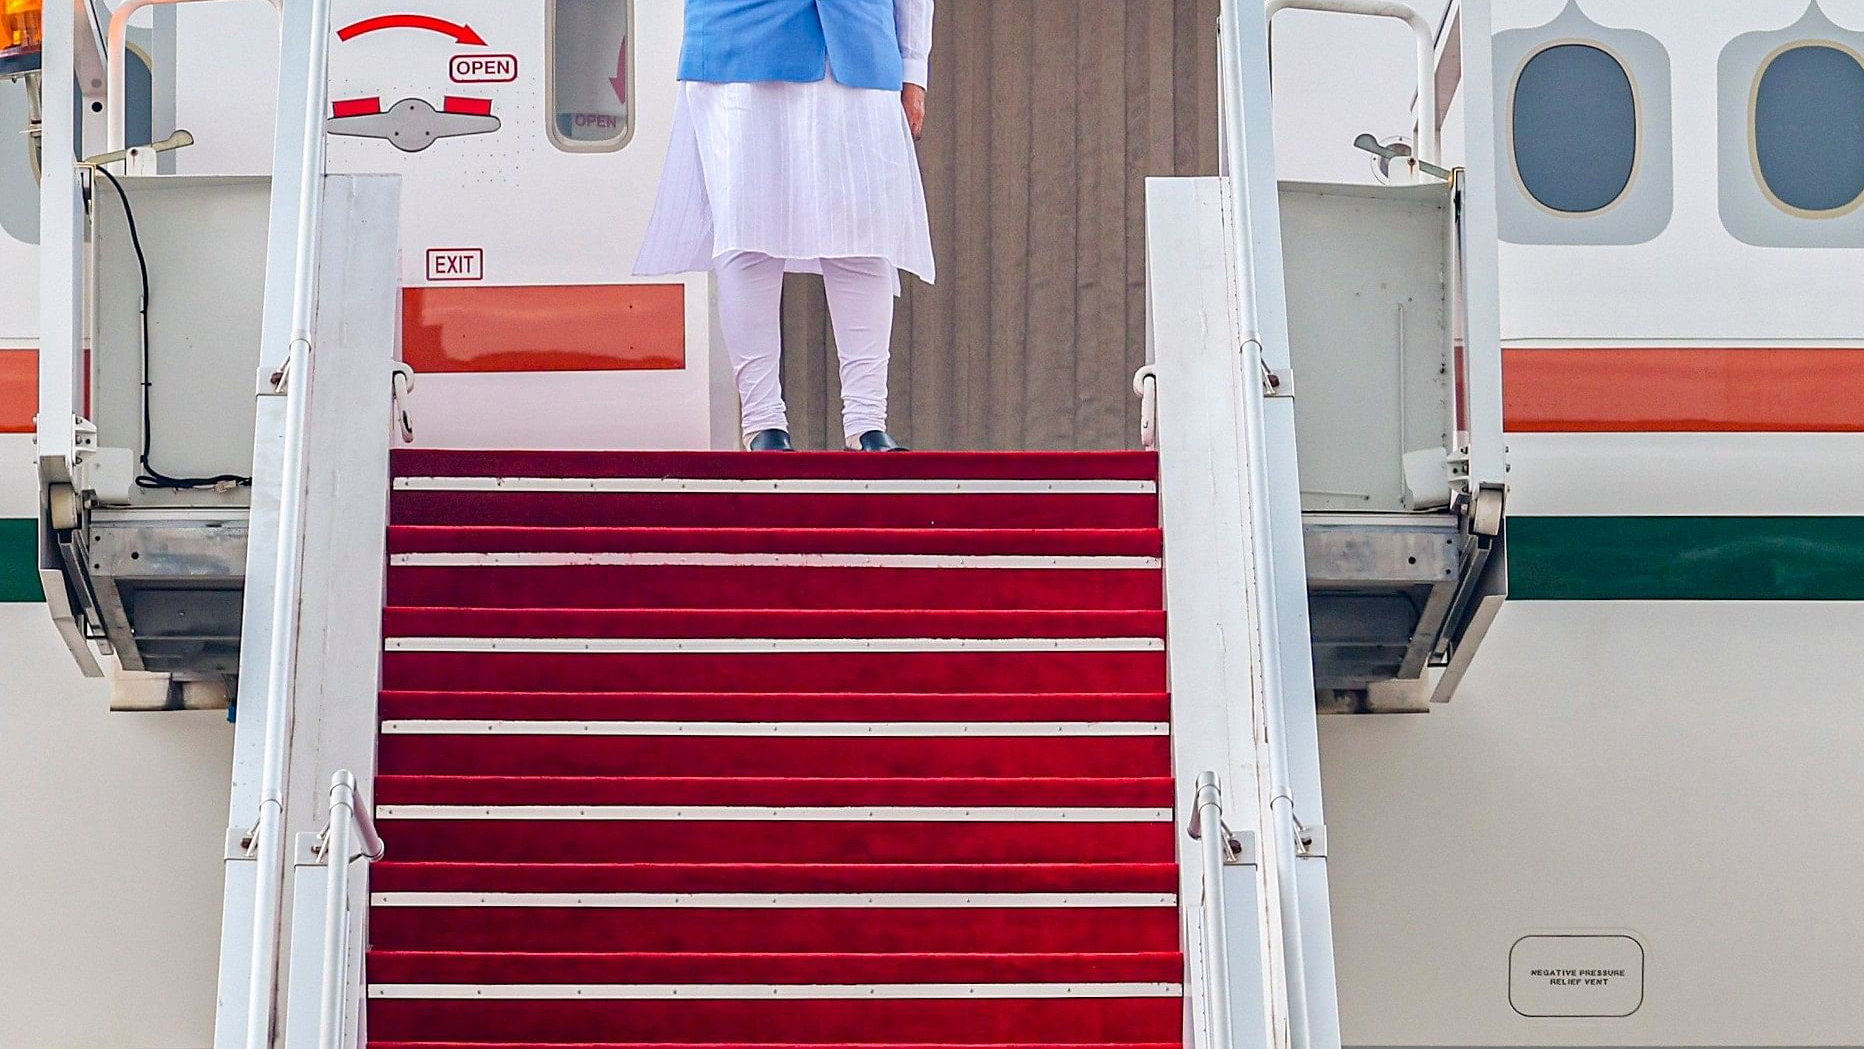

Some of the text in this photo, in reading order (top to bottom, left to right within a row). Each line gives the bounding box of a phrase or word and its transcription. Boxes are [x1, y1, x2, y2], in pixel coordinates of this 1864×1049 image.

[456, 60, 510, 75] OPEN
[574, 114, 617, 128] OPEN
[435, 255, 474, 275] EXIT
